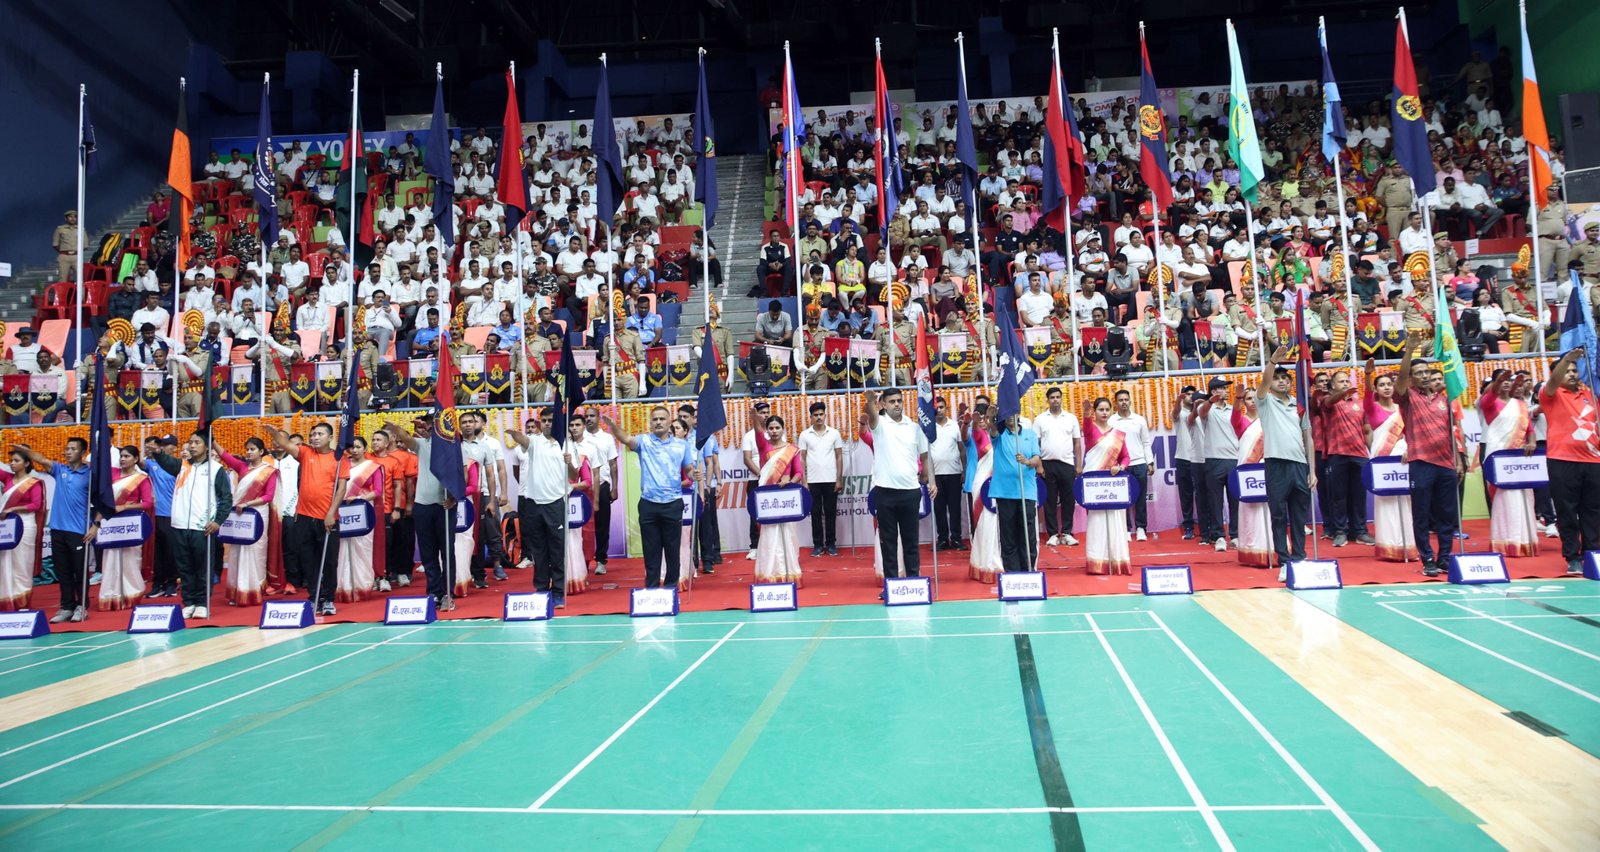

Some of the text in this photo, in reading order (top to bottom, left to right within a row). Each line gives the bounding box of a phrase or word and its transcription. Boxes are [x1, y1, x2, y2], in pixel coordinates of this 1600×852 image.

[316, 138, 386, 162] YOEX
[918, 407, 932, 427] POLICE
[1503, 462, 1540, 474] गुजरात
[1383, 470, 1409, 481] गोव
[1470, 563, 1494, 573] गोवा
[268, 609, 298, 620] बिहार
